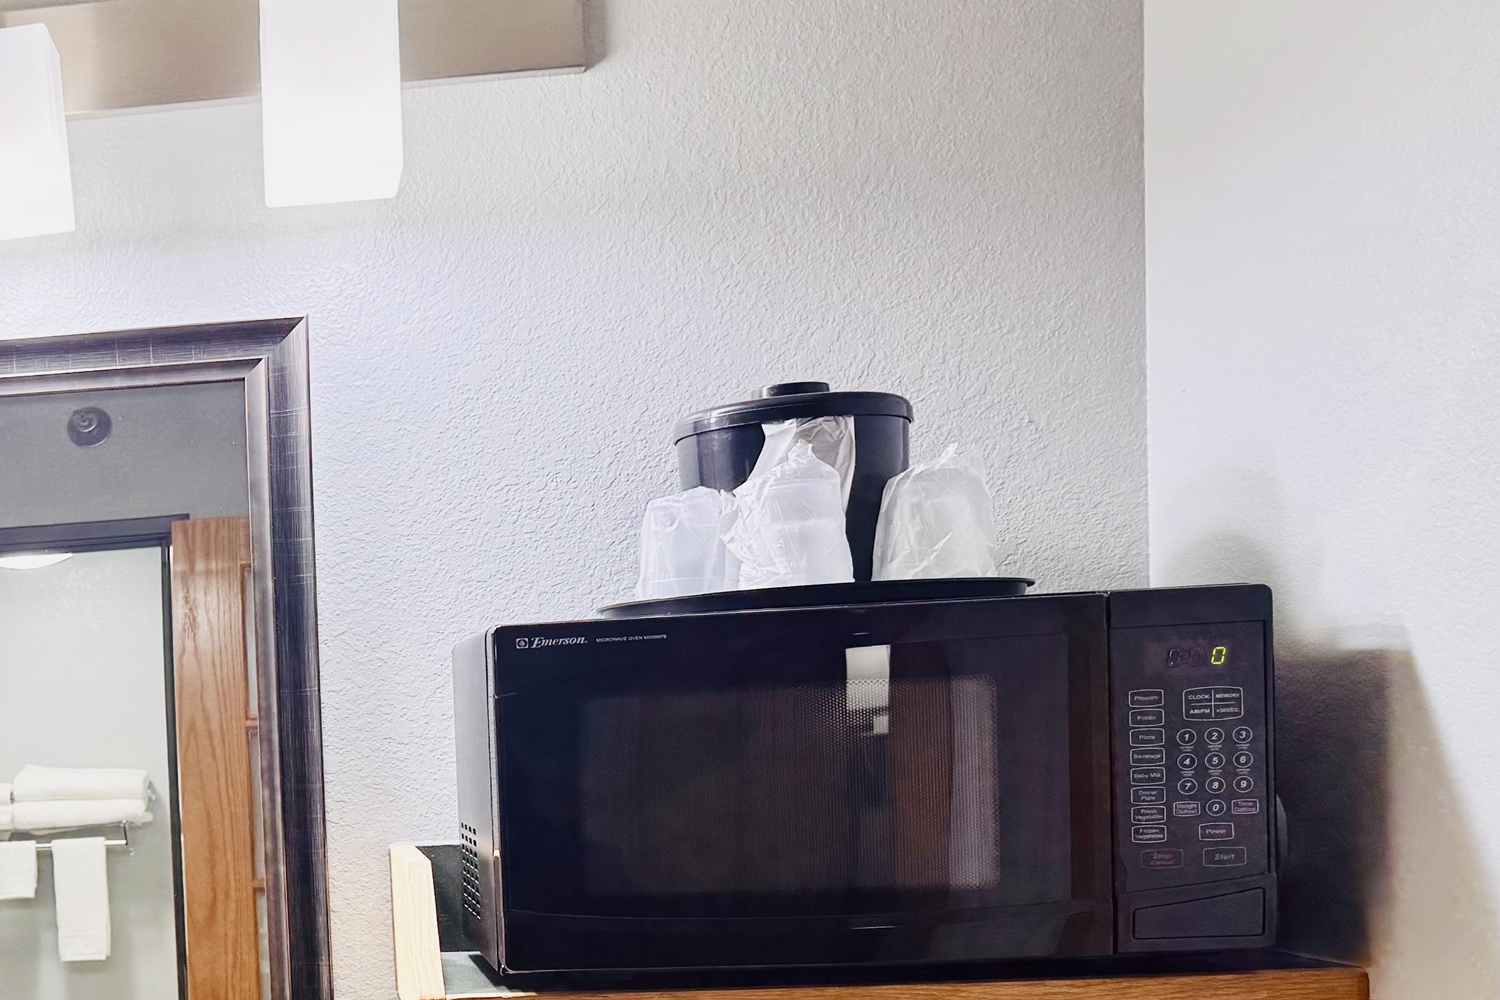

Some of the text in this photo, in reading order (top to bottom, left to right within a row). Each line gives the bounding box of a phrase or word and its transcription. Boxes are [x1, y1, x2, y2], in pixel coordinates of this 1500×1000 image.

[1211, 646, 1226, 665] 0
[1184, 733, 1190, 741] 1
[1211, 732, 1218, 740] 2
[1239, 730, 1246, 739] 3
[1183, 757, 1191, 765] 4
[1212, 756, 1219, 765] 5
[1239, 755, 1247, 763] 6
[1185, 782, 1192, 790] 7
[1212, 781, 1219, 789] 8
[1240, 780, 1247, 788] 9
[1212, 803, 1219, 812] 0
